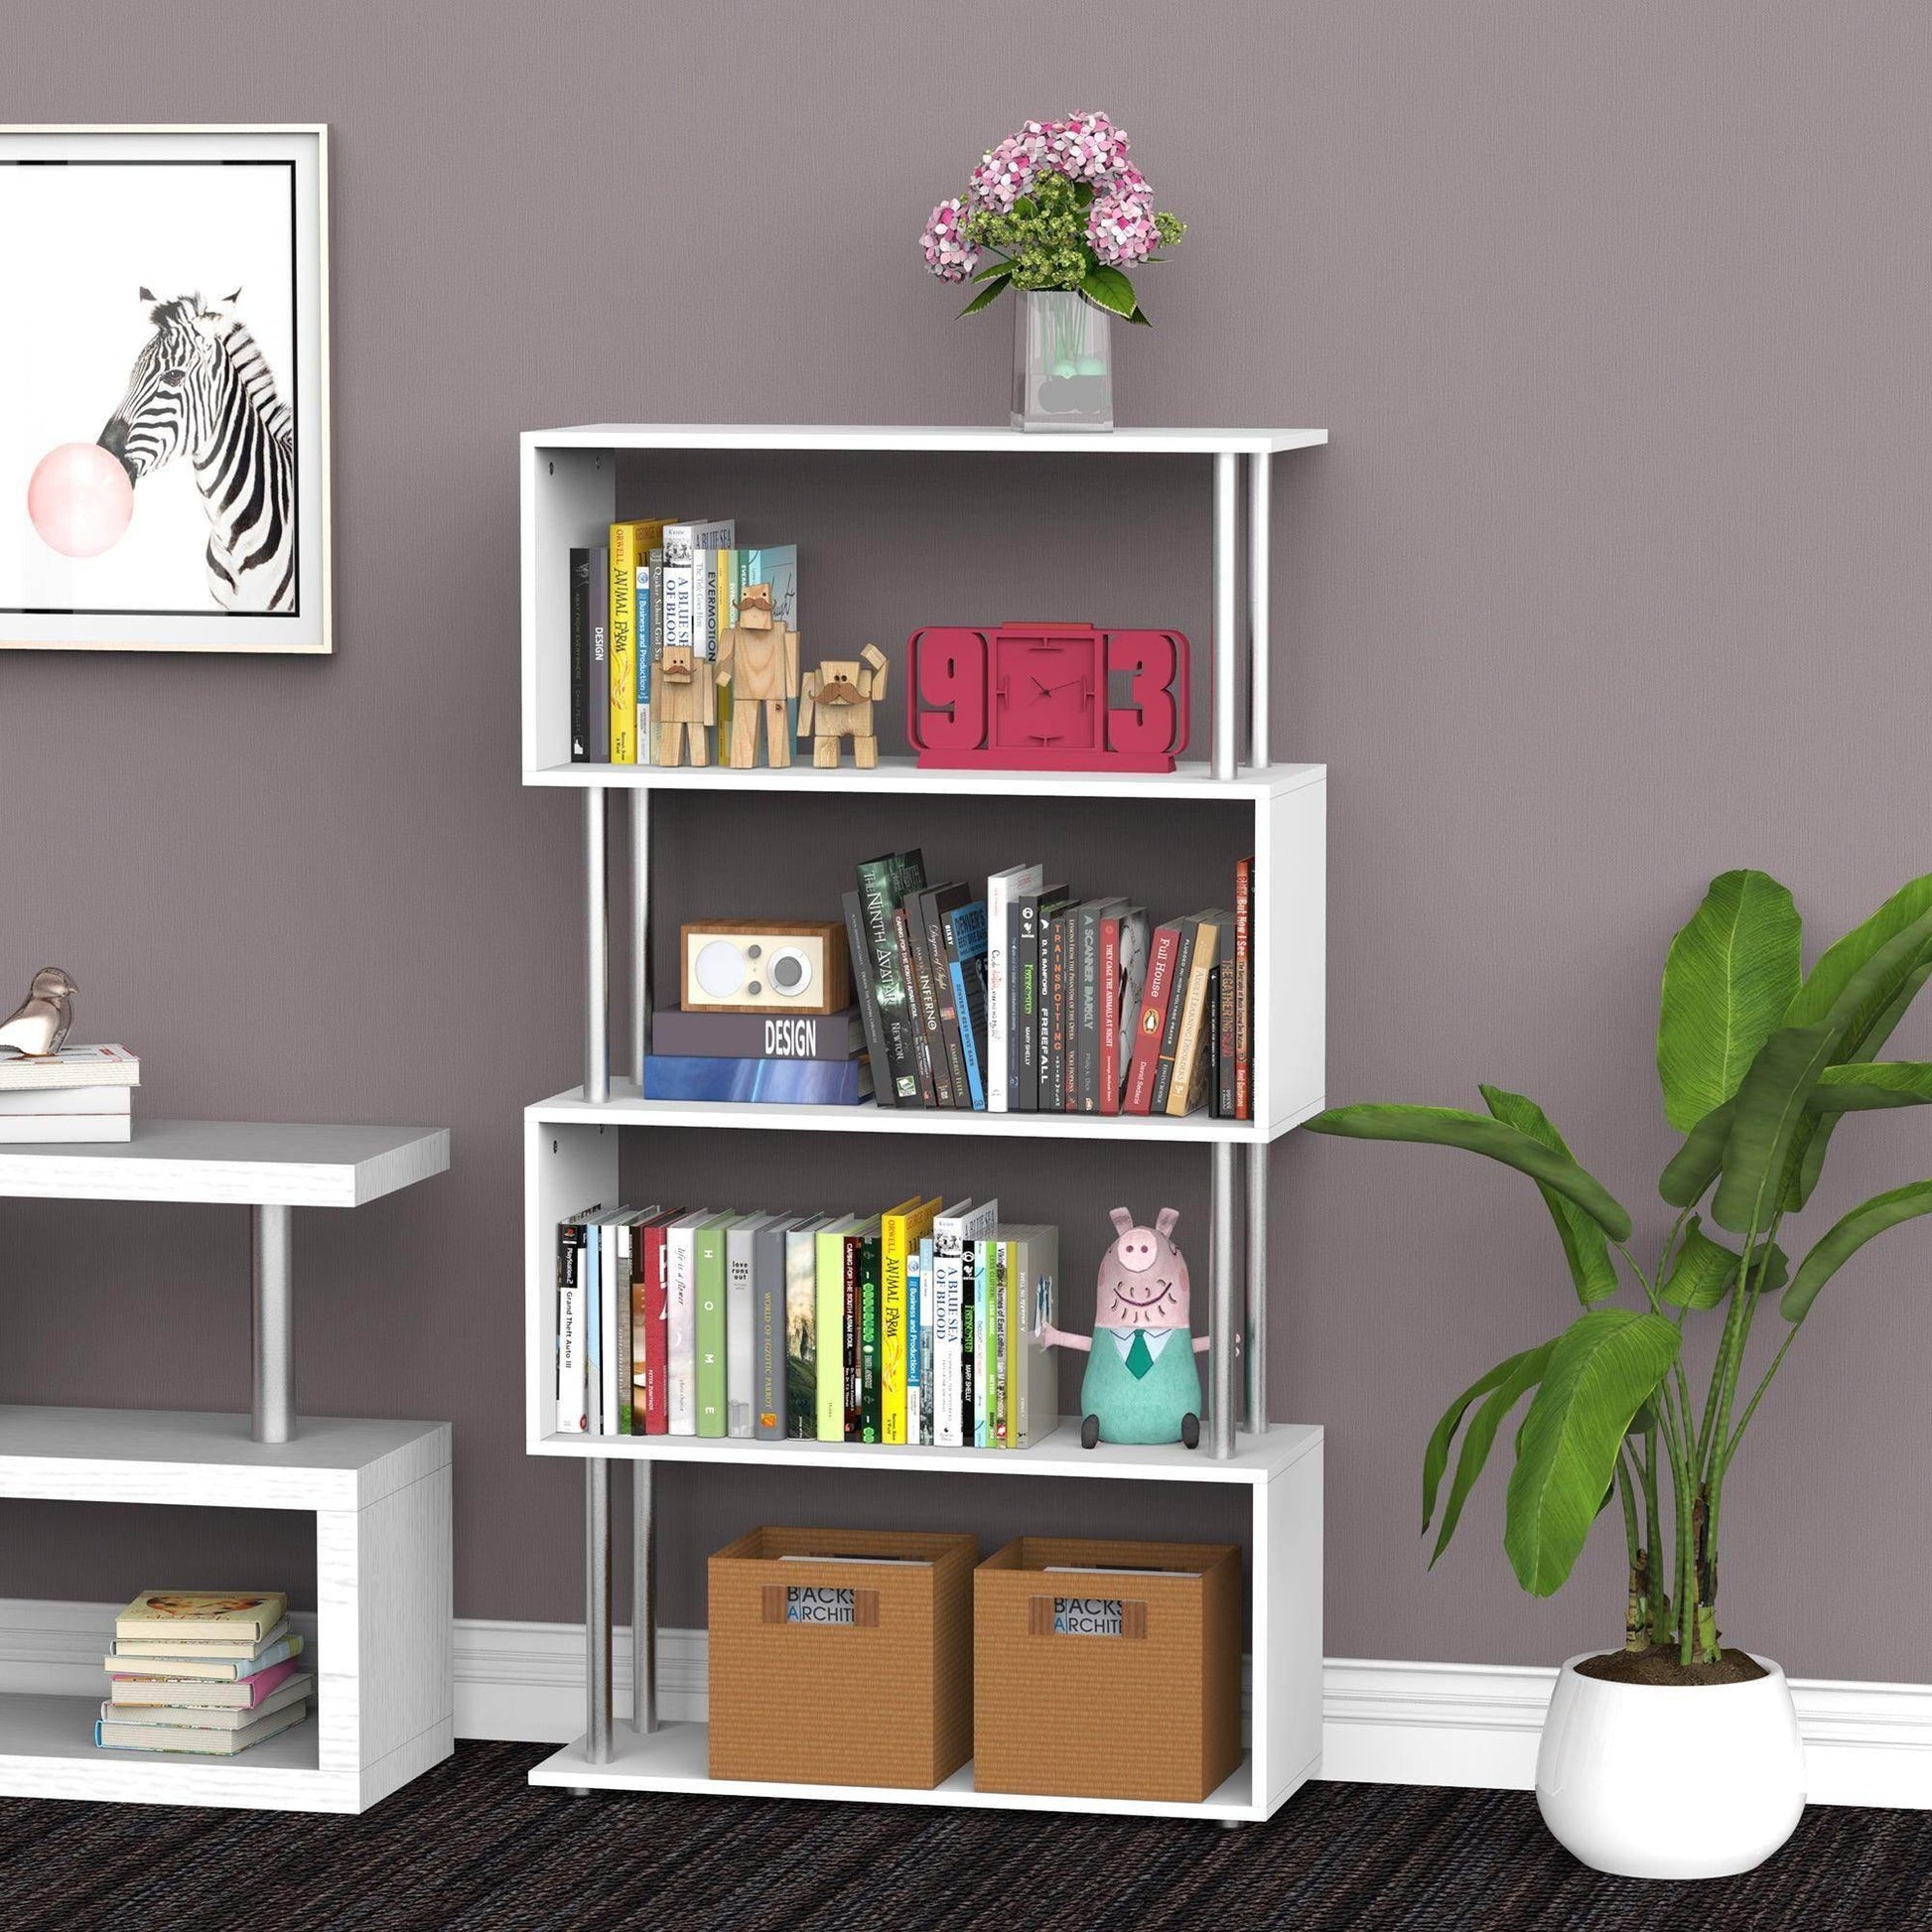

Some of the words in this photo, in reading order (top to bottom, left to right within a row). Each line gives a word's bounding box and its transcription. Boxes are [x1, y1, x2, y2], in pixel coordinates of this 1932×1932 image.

[616, 529, 624, 566] ORWELL
[694, 563, 705, 575] The
[614, 568, 628, 618] ANIMAL
[665, 580, 676, 599] OF
[678, 577, 689, 587] A
[694, 575, 705, 593] Title
[637, 600, 647, 631] Business
[678, 591, 689, 628] BLUE
[707, 571, 717, 662] EVERMOTION
[665, 602, 676, 647] BLOO
[595, 626, 605, 661] DESIGN
[615, 621, 629, 653] FARM
[638, 632, 647, 649] and
[637, 650, 647, 692] Production
[918, 630, 989, 752] 9
[1107, 632, 1177, 754] 3
[1237, 898, 1248, 915] But
[1084, 915, 1094, 925] A
[1237, 915, 1248, 934] Now
[1084, 929, 1094, 982] SCANNER
[1105, 944, 1114, 960] THEY
[1157, 937, 1171, 960] Full
[1237, 939, 1248, 956] See
[1105, 960, 1114, 978] CAGE
[1151, 961, 1167, 999] House
[1105, 978, 1114, 990] THE
[876, 948, 899, 1007] AVATAR
[890, 1023, 904, 1060] NEWTON
[919, 974, 938, 1031] INFERNO
[1105, 990, 1114, 1018] ANIMALS
[1105, 1018, 1114, 1028] AT
[763, 1020, 817, 1057] DESIGN
[1105, 1028, 1114, 1047] NIGHT
[1137, 1060, 1148, 1080] David
[1133, 1080, 1145, 1105] Sedaris
[888, 1219, 897, 1254] ORWELL
[675, 1247, 686, 1261] life
[846, 1243, 855, 1267] CARING
[996, 1248, 1005, 1268] Viking
[846, 1267, 855, 1280] FOR
[885, 1256, 900, 1304] ANIMAL
[935, 1269, 947, 1290] OF
[947, 1266, 959, 1277] A
[675, 1280, 686, 1307] flower
[846, 1280, 855, 1293] THE
[947, 1278, 959, 1316] BLUE
[846, 1293, 855, 1314] SOUTH
[908, 1287, 919, 1318] Business
[846, 1314, 855, 1332] ASIAN
[885, 1307, 901, 1338] FARM
[908, 1318, 919, 1333] and
[935, 1291, 947, 1340] BLOOD
[703, 1249, 714, 1415] HOME
[846, 1332, 855, 1349] SOUL
[947, 1317, 959, 1343] SEA
[908, 1334, 919, 1375] Production
